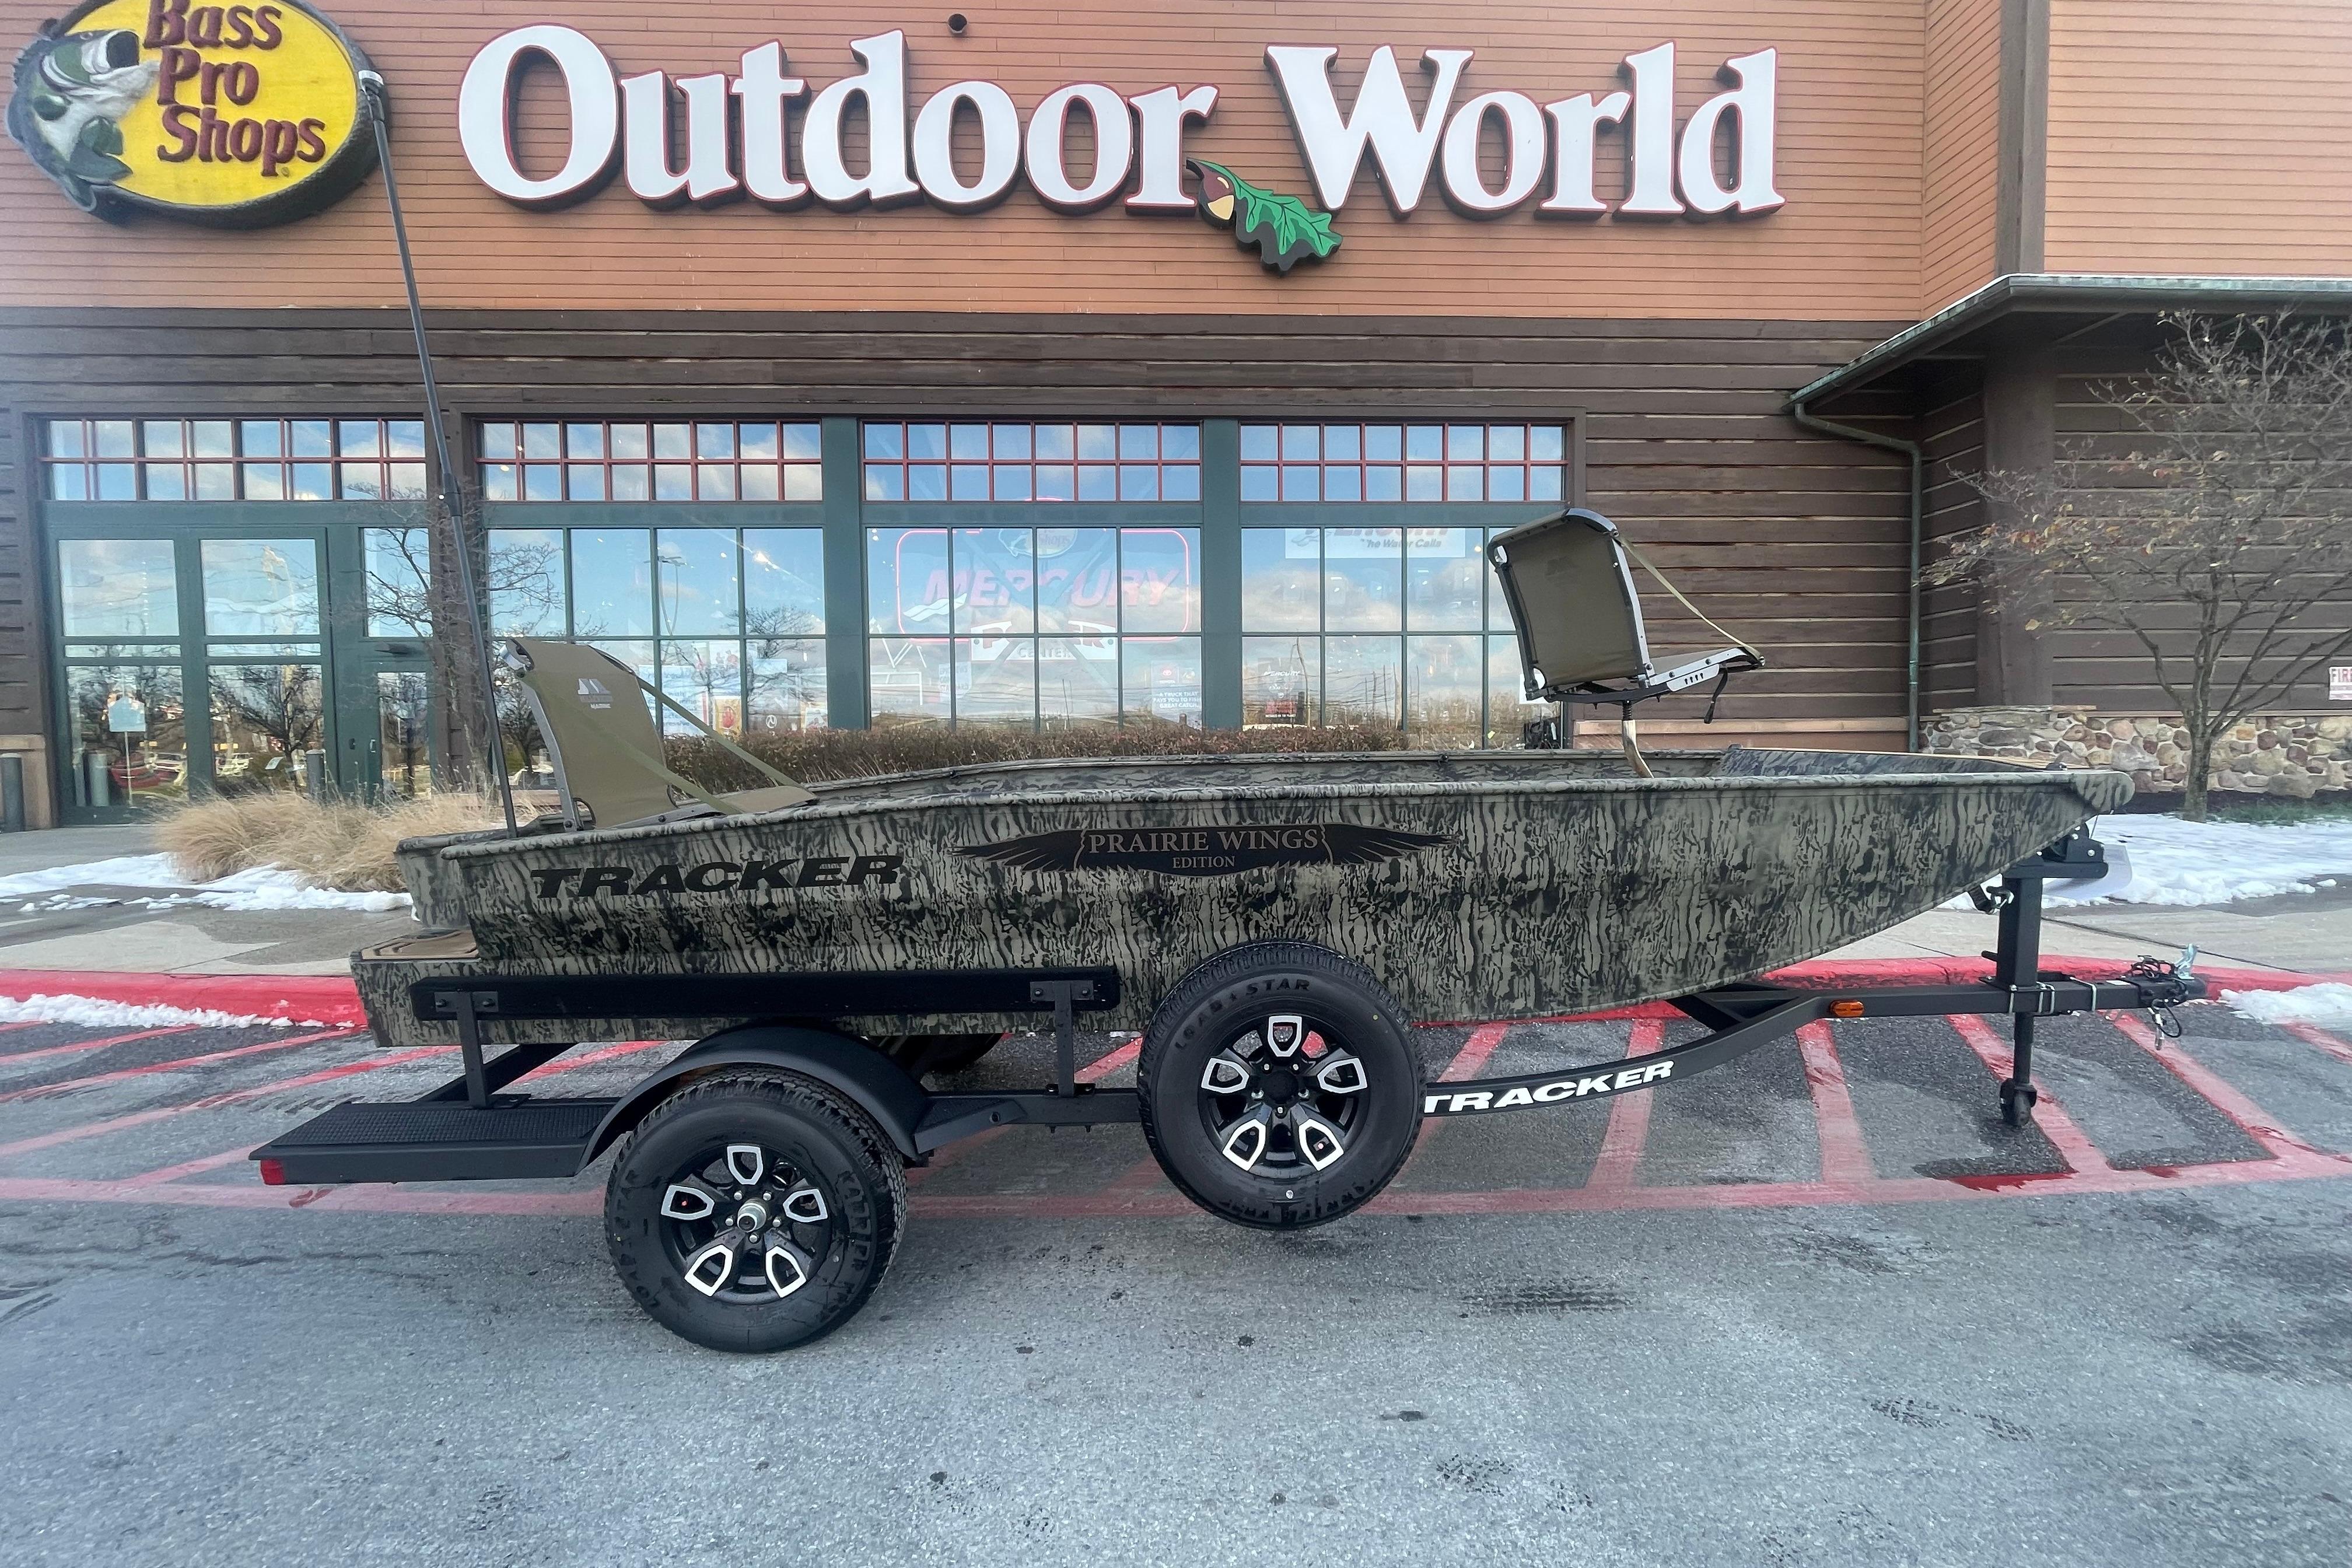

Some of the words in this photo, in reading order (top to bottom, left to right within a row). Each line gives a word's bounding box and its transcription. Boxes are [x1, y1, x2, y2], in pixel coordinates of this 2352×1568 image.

[143, 0, 282, 50] Bass
[156, 46, 260, 106] Pro
[158, 104, 326, 177] Shops
[458, 22, 1220, 211] Outdoor
[1265, 40, 1787, 216] World
[1383, 538, 1413, 548] War
[2330, 668, 2352, 682] FIR
[1088, 831, 1209, 853] PRAIRIE
[1217, 829, 1318, 850] WINGS
[1172, 856, 1236, 869] EDITION
[530, 855, 904, 898] TRACKER
[1424, 1060, 1675, 1113] TRACKER
